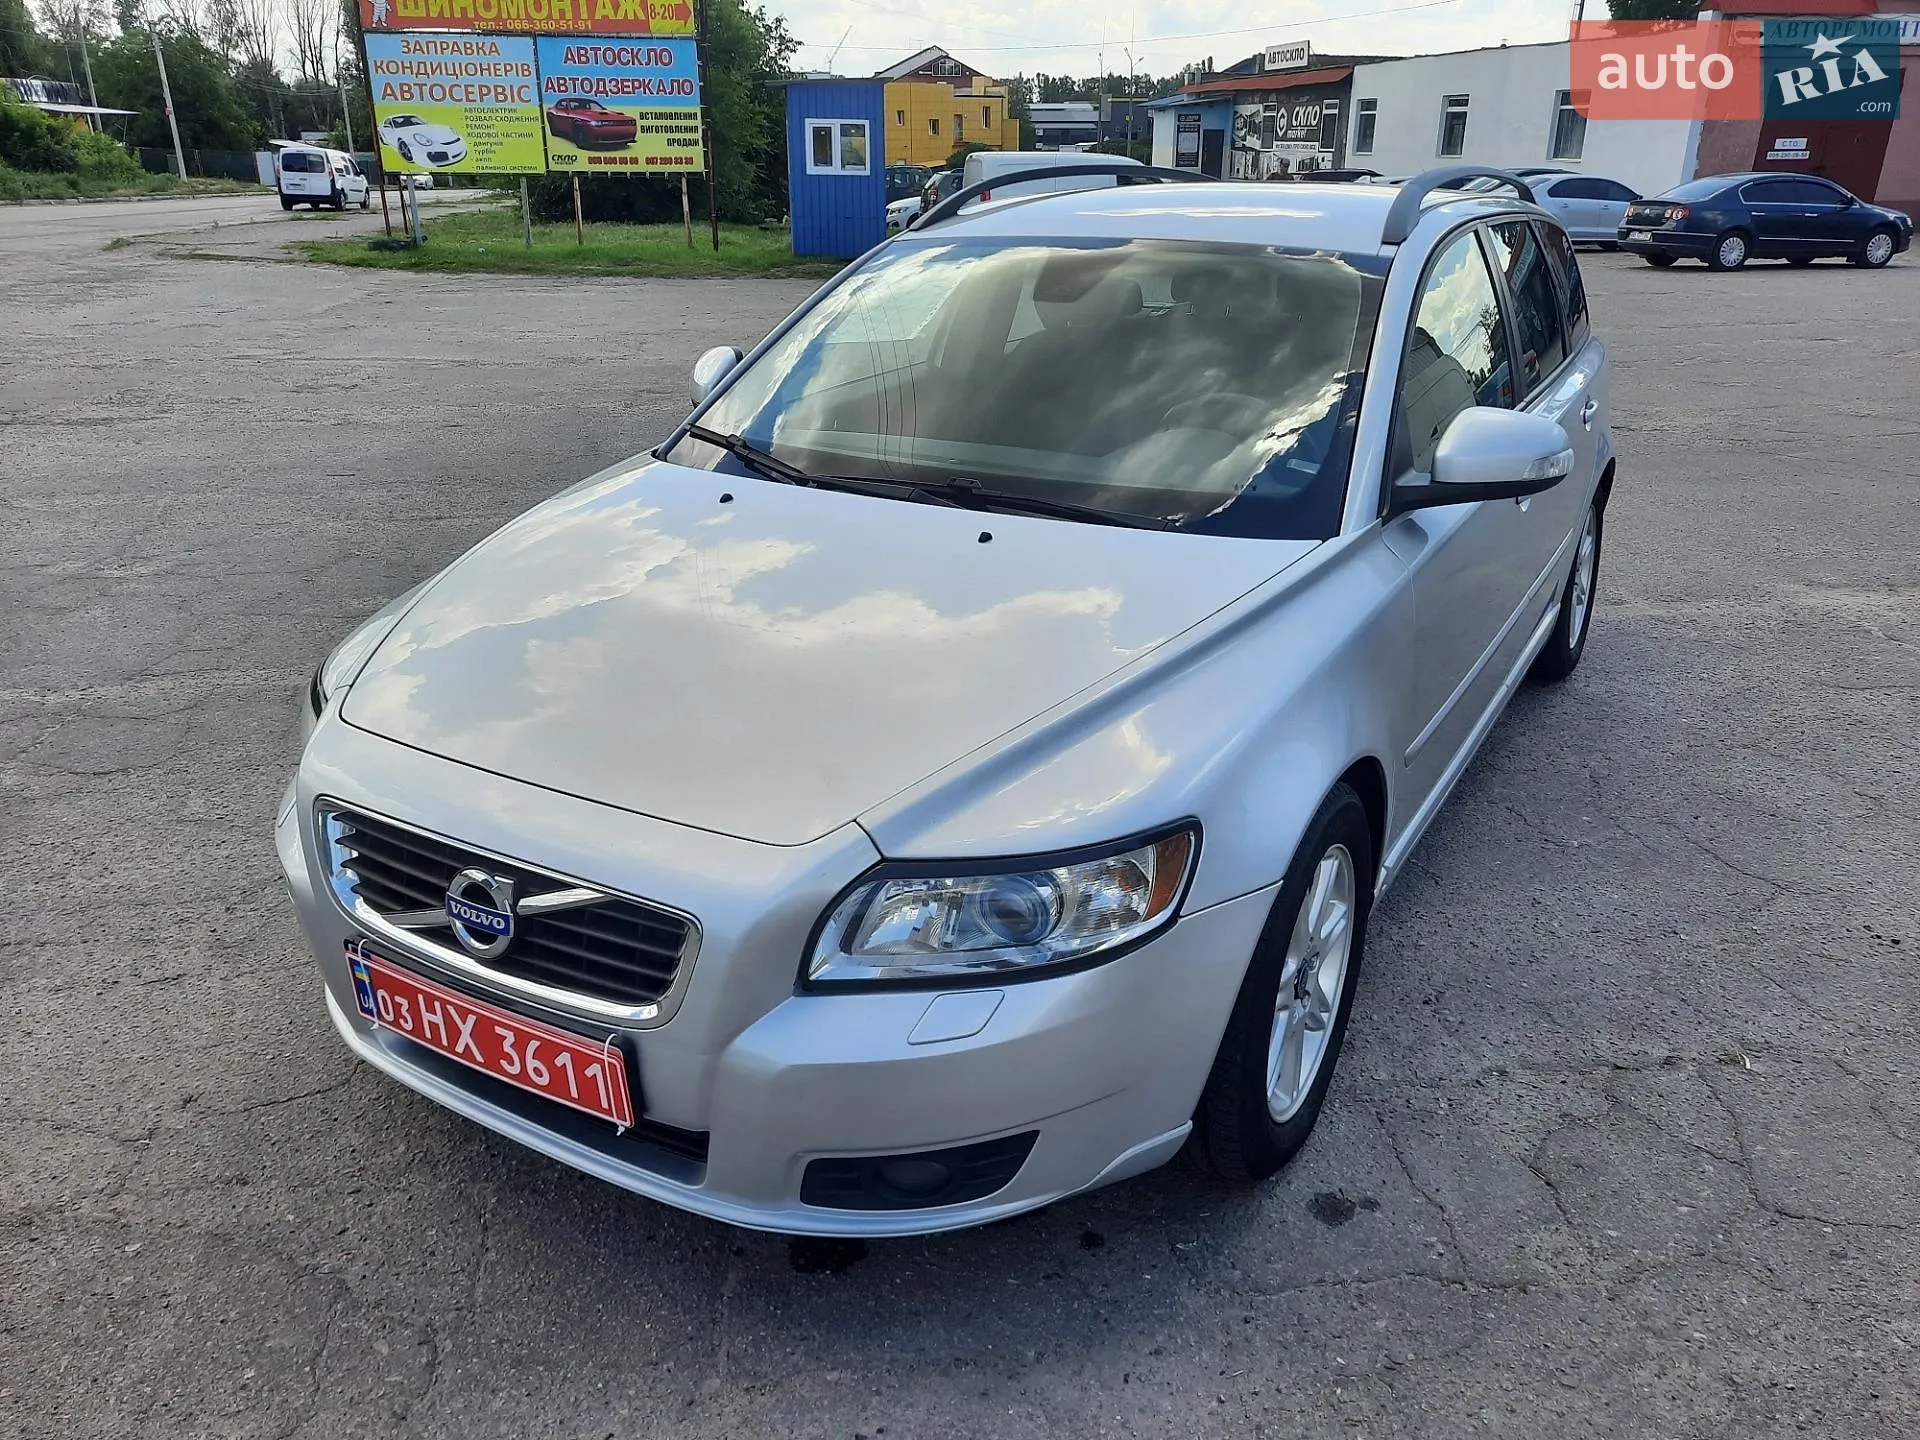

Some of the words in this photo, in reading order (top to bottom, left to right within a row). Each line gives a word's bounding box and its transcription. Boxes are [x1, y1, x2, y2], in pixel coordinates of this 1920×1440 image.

[396, 0, 647, 20] ШИНОМОНТАЖ
[650, 3, 674, 21] 8-20
[474, 21, 503, 29] тел.:
[507, 20, 592, 30] 066-360-51-91
[400, 39, 500, 56] ЗАПРАВКА
[563, 46, 674, 67] АВТОСКЛО
[1267, 47, 1306, 65] АВТОСКЛО
[374, 60, 532, 80] КОНДИЦІОНЕРІВ
[381, 82, 532, 104] АВТОСЕРВІС
[544, 76, 695, 98] АВТОДЗЕРКАЛО
[639, 112, 698, 121] ВСТАНОВЛЕННЯ
[1292, 105, 1321, 126] СКЛО
[640, 125, 699, 134] ВИГОТОВЛЕННЯ
[449, 900, 506, 930] VOLVO
[376, 988, 414, 1031] 03
[417, 993, 484, 1064] HX
[494, 1024, 610, 1110] 3611
